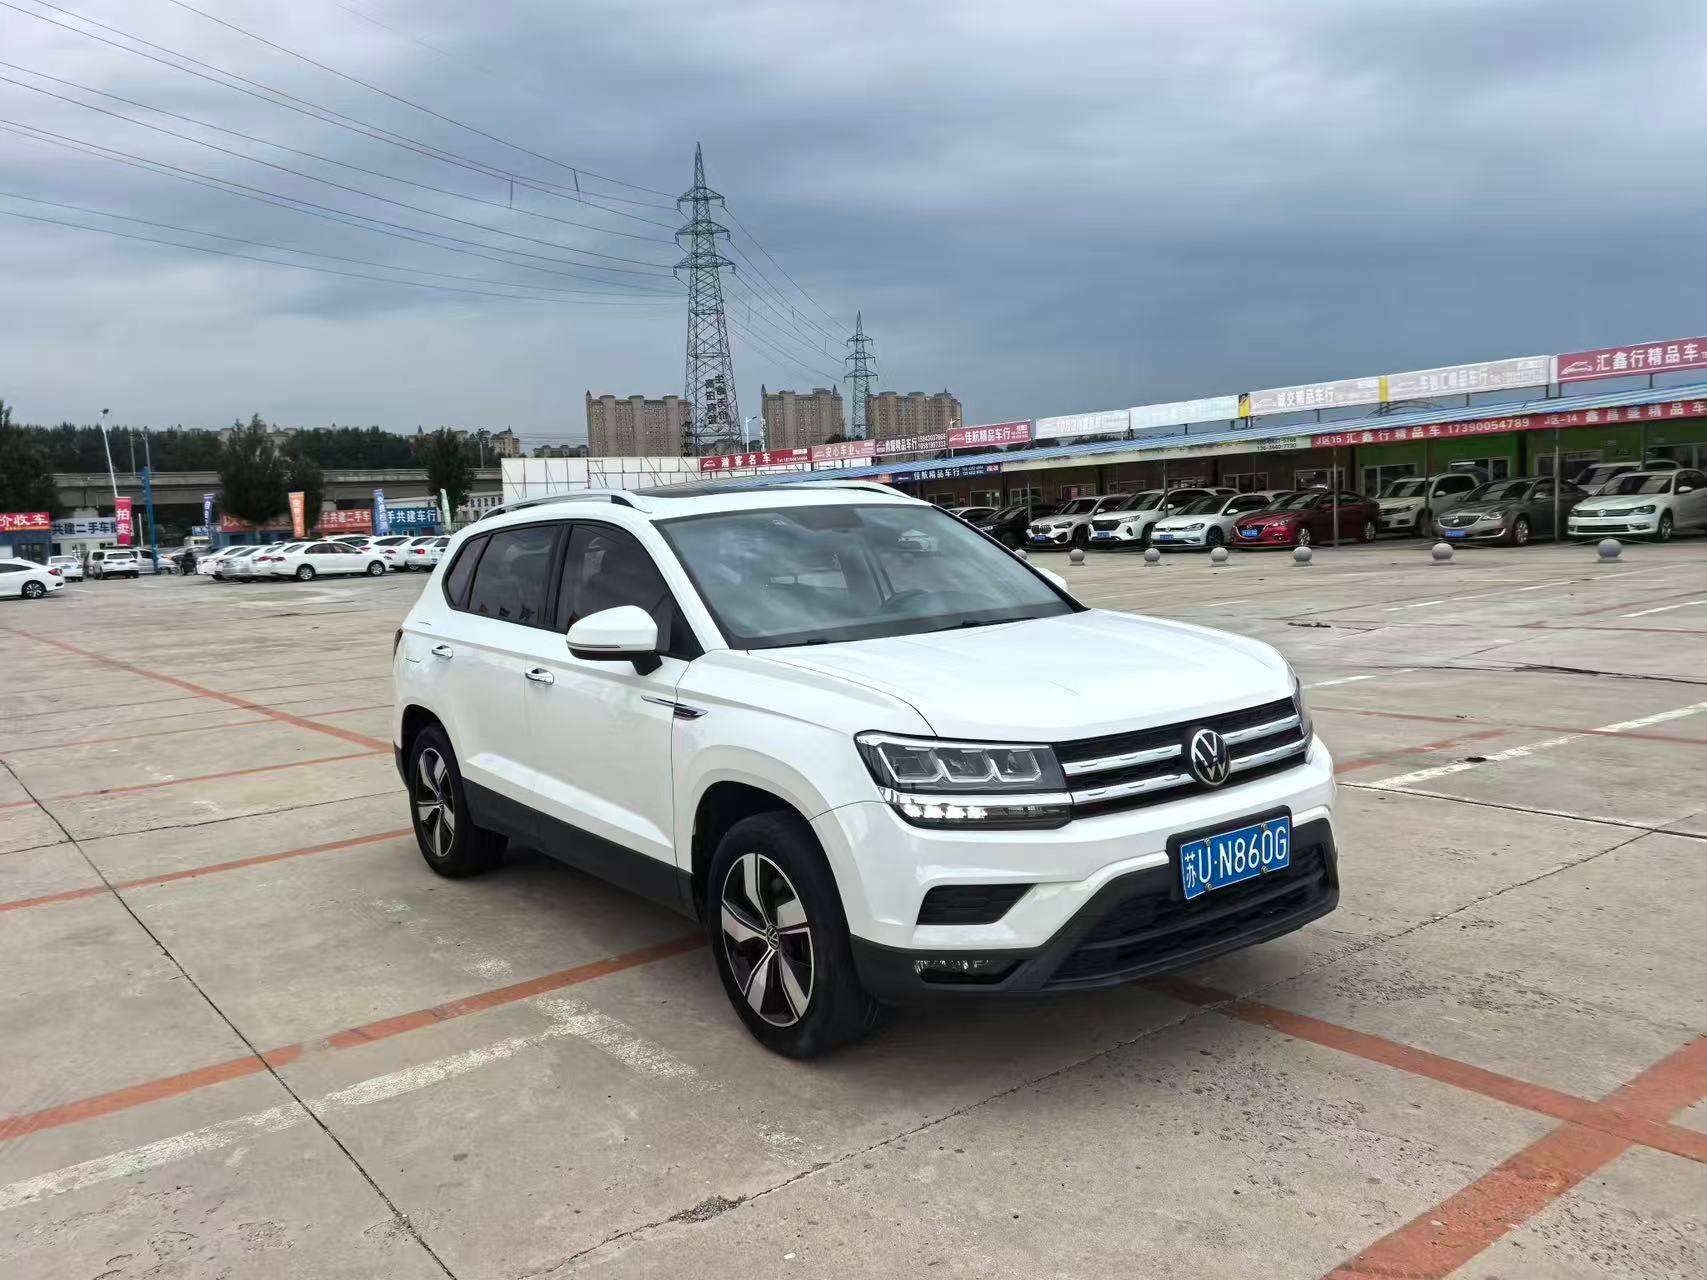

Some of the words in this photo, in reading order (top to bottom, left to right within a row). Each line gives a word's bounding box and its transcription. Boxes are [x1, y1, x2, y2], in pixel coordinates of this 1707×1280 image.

[1596, 343, 1698, 371] 汇鑫行精品车
[965, 428, 1011, 443] 佳航精品车行
[1346, 425, 1441, 444] 汇鑫行精品车
[1447, 418, 1530, 433] 17390054789
[913, 467, 960, 481] 佳航精品车行
[116, 508, 129, 535] 拍卖
